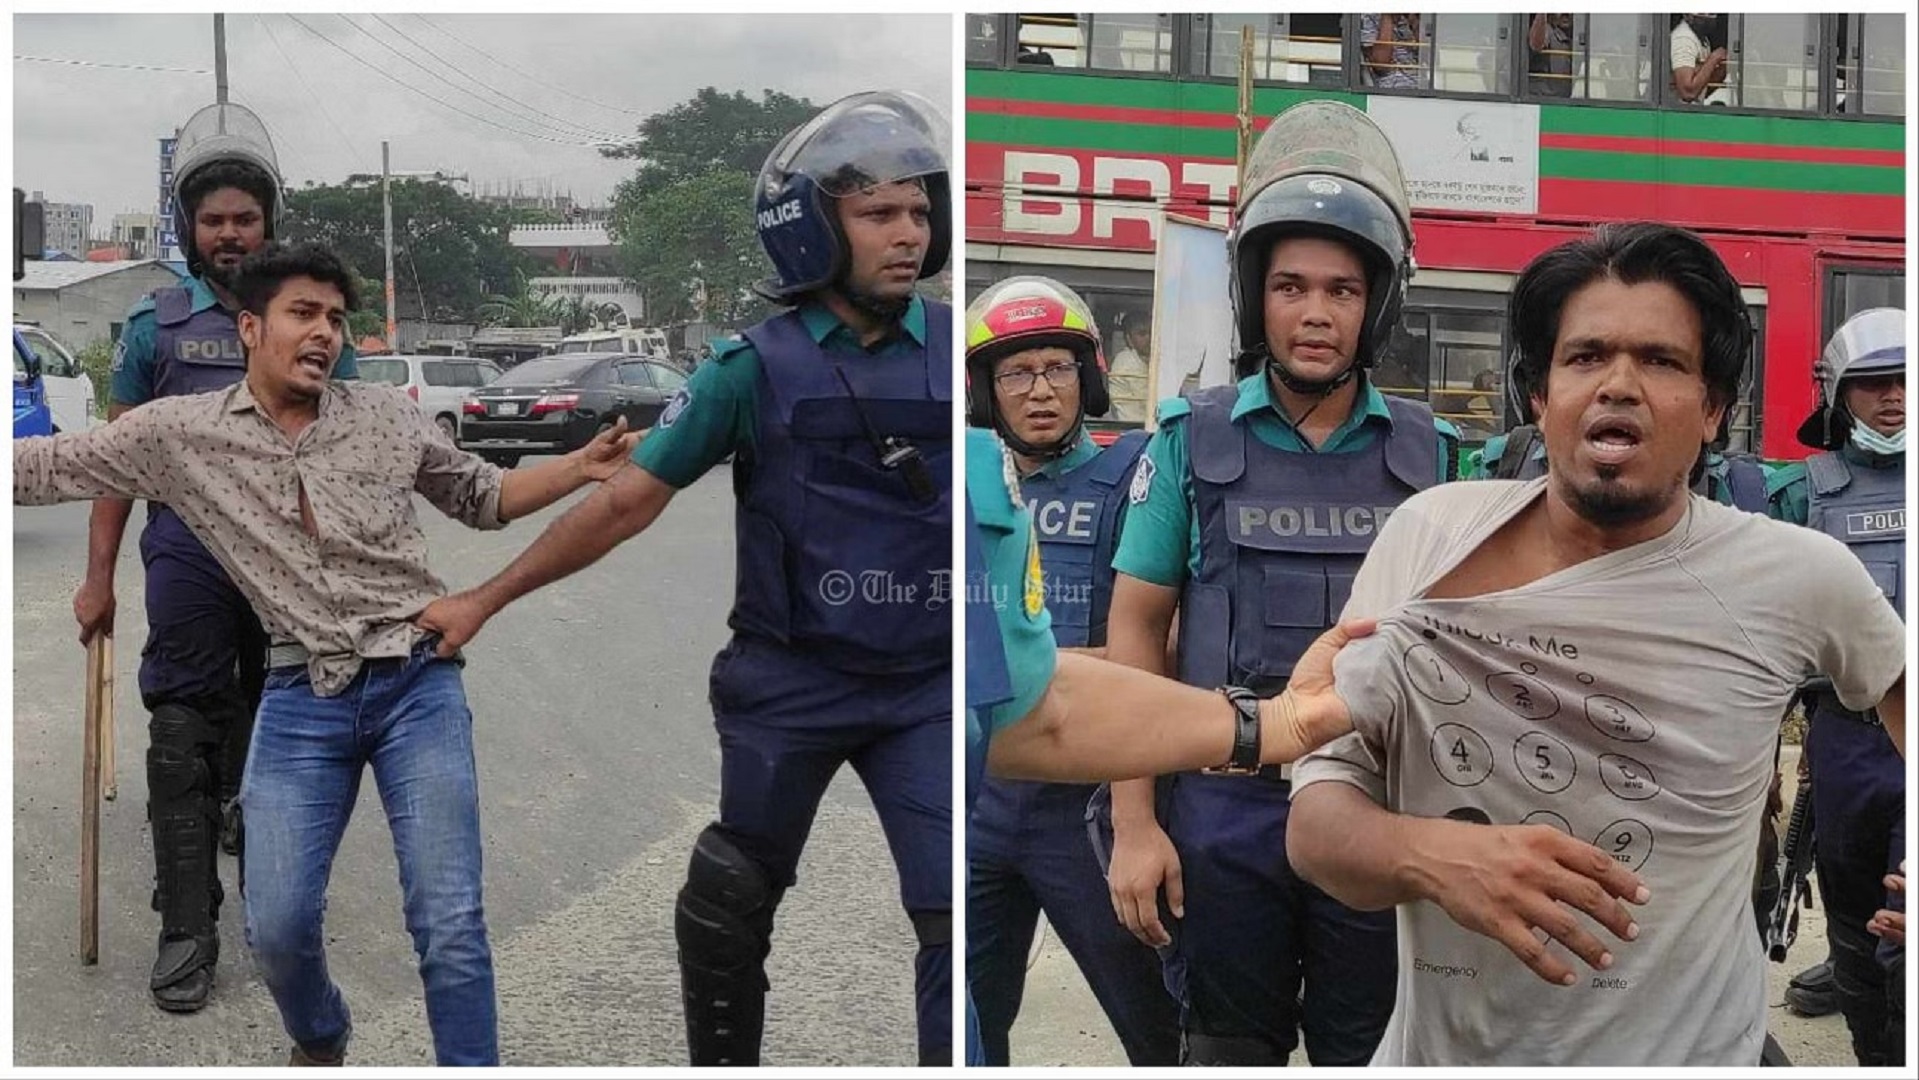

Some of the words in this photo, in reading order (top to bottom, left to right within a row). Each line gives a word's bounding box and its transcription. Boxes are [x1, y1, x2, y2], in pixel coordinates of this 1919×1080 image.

[1863, 512, 1905, 531] POLI
[1529, 635, 1579, 660] Me
[1450, 736, 1469, 763] 4
[1535, 745, 1551, 769] 5
[1613, 832, 1632, 852] 9
[1413, 957, 1478, 980] Emergency
[1592, 976, 1629, 990] Delete
